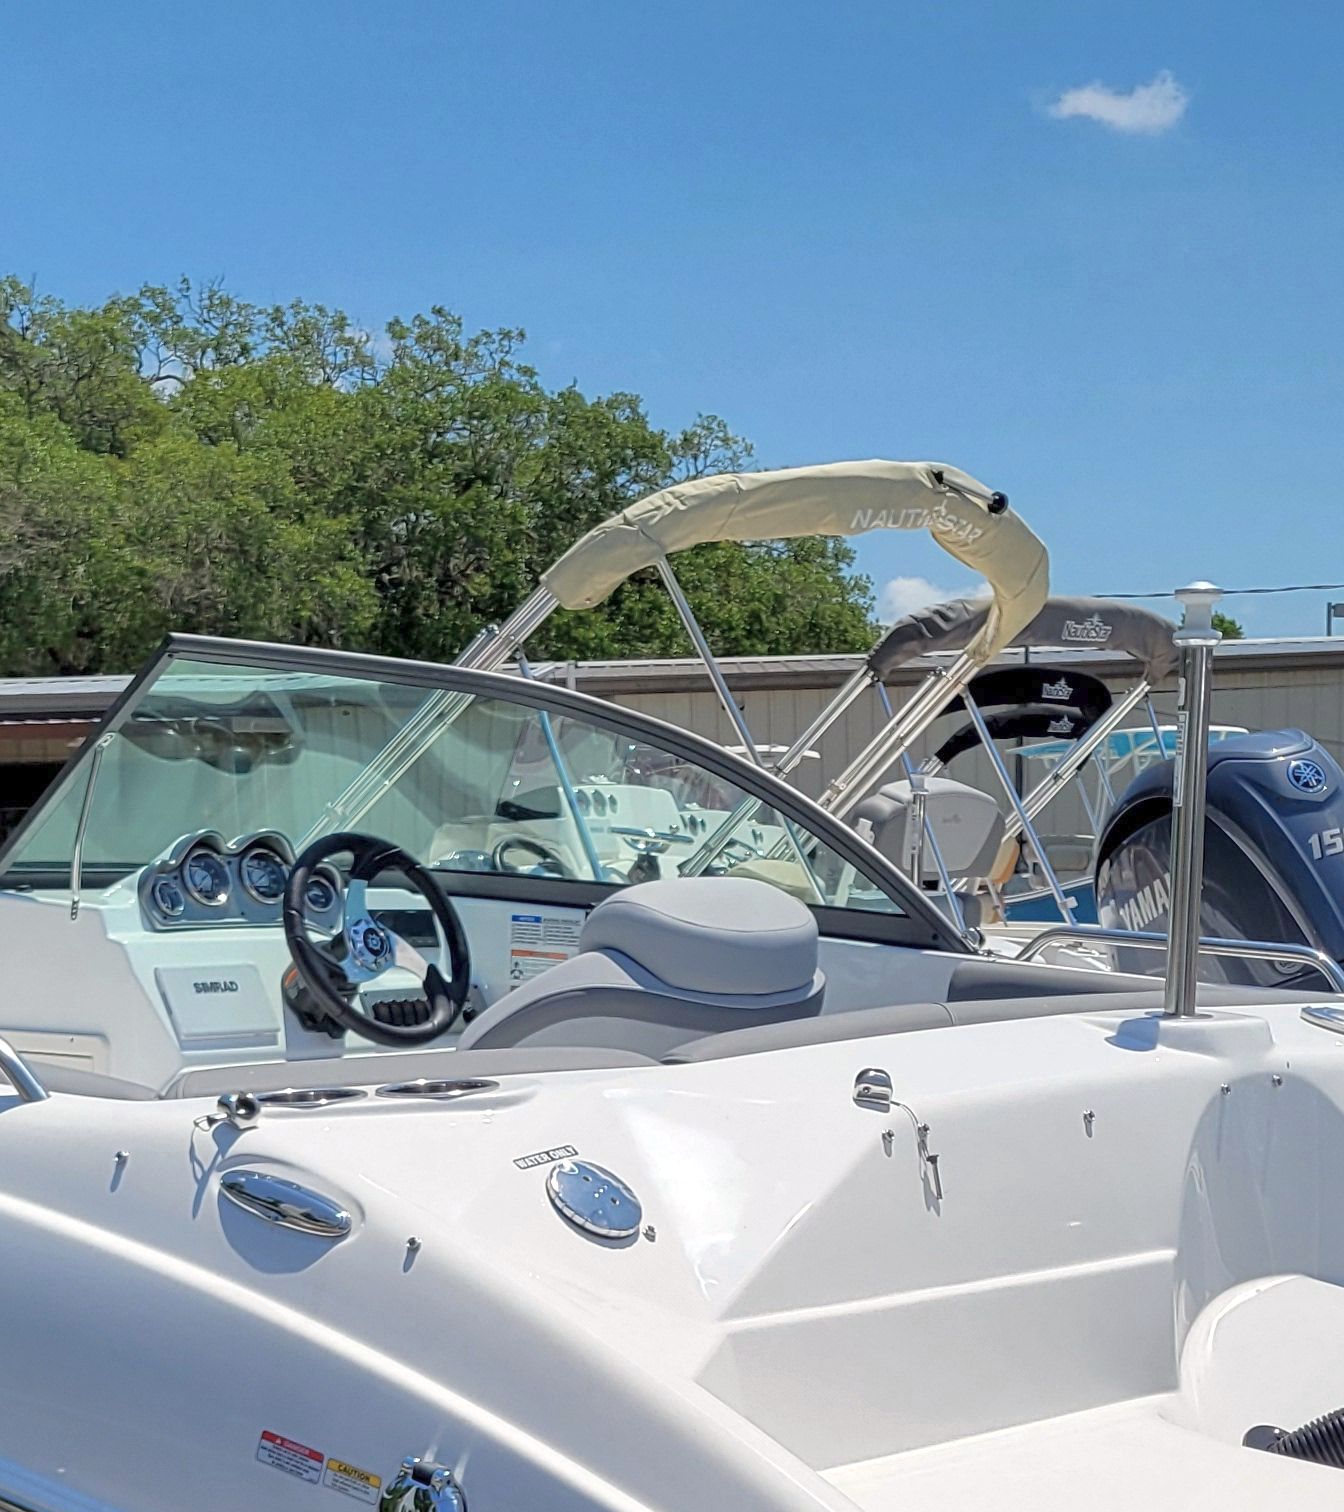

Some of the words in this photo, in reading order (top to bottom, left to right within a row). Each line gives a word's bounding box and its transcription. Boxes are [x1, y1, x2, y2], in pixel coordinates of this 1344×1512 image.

[193, 981, 239, 994] SIMRAD
[514, 1152, 552, 1169] WATER
[549, 1146, 578, 1161] ONLY
[337, 1463, 370, 1482] CAUTION
